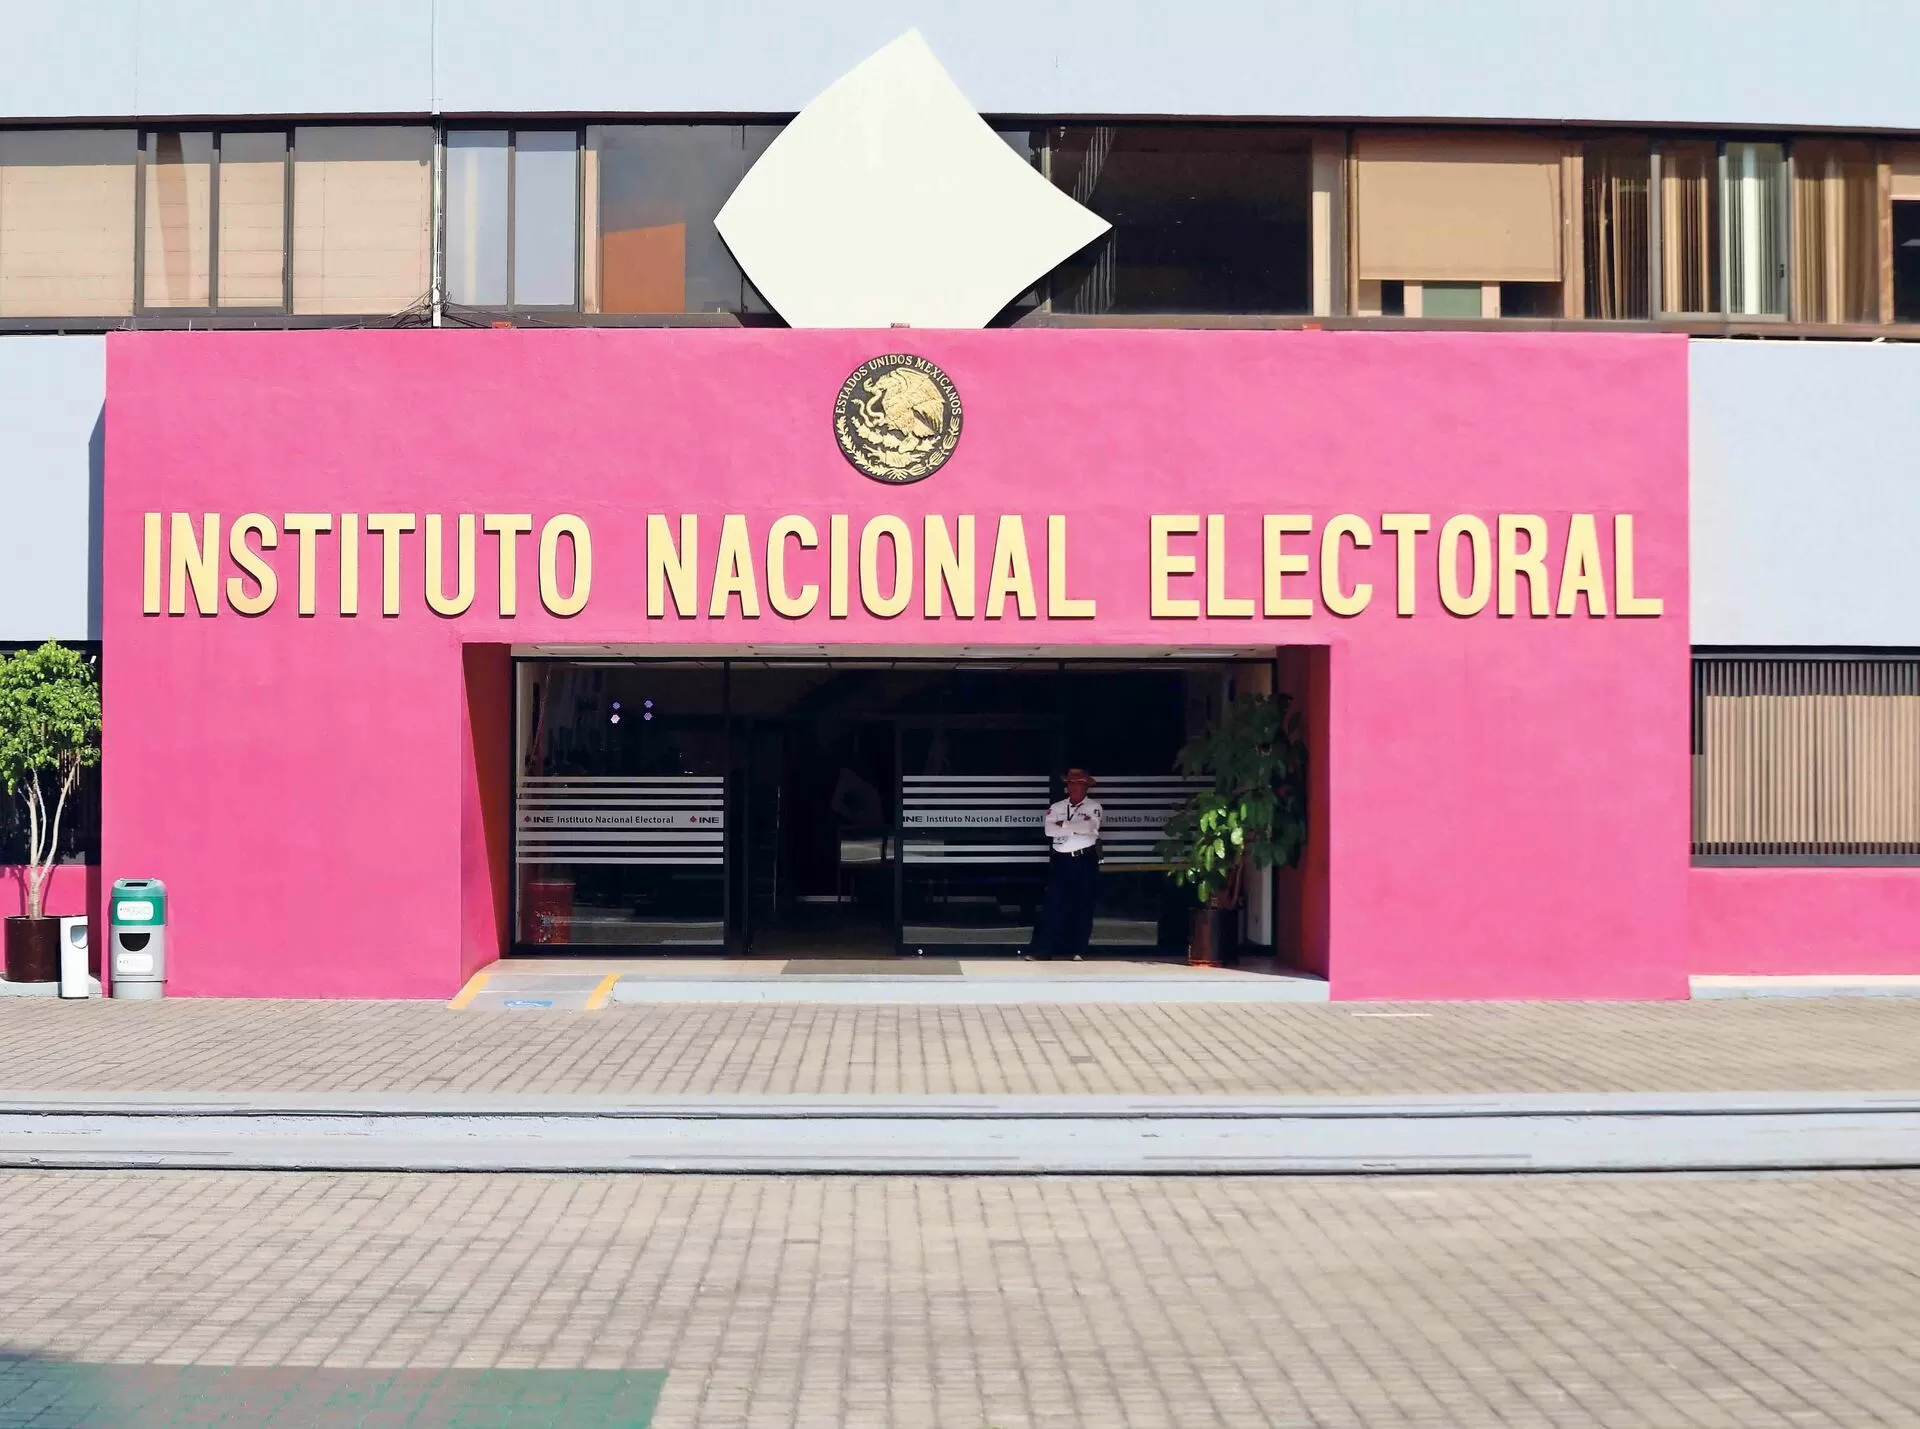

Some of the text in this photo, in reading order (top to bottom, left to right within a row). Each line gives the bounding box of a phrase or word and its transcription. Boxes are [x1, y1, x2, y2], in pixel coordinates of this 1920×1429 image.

[835, 354, 962, 416] ESTADOS UNIDOS MEXICANOS
[143, 512, 1664, 619] INSTITUTO NACIONAL ELECTORAL
[557, 815, 594, 824] Instituto
[595, 815, 633, 824] Nacional
[635, 815, 674, 824] Electoral
[699, 816, 720, 824] INE
[926, 815, 963, 823] Instituto
[964, 815, 1002, 823] Nacional
[1004, 815, 1043, 823] Electoral
[1105, 815, 1142, 823] Instituto
